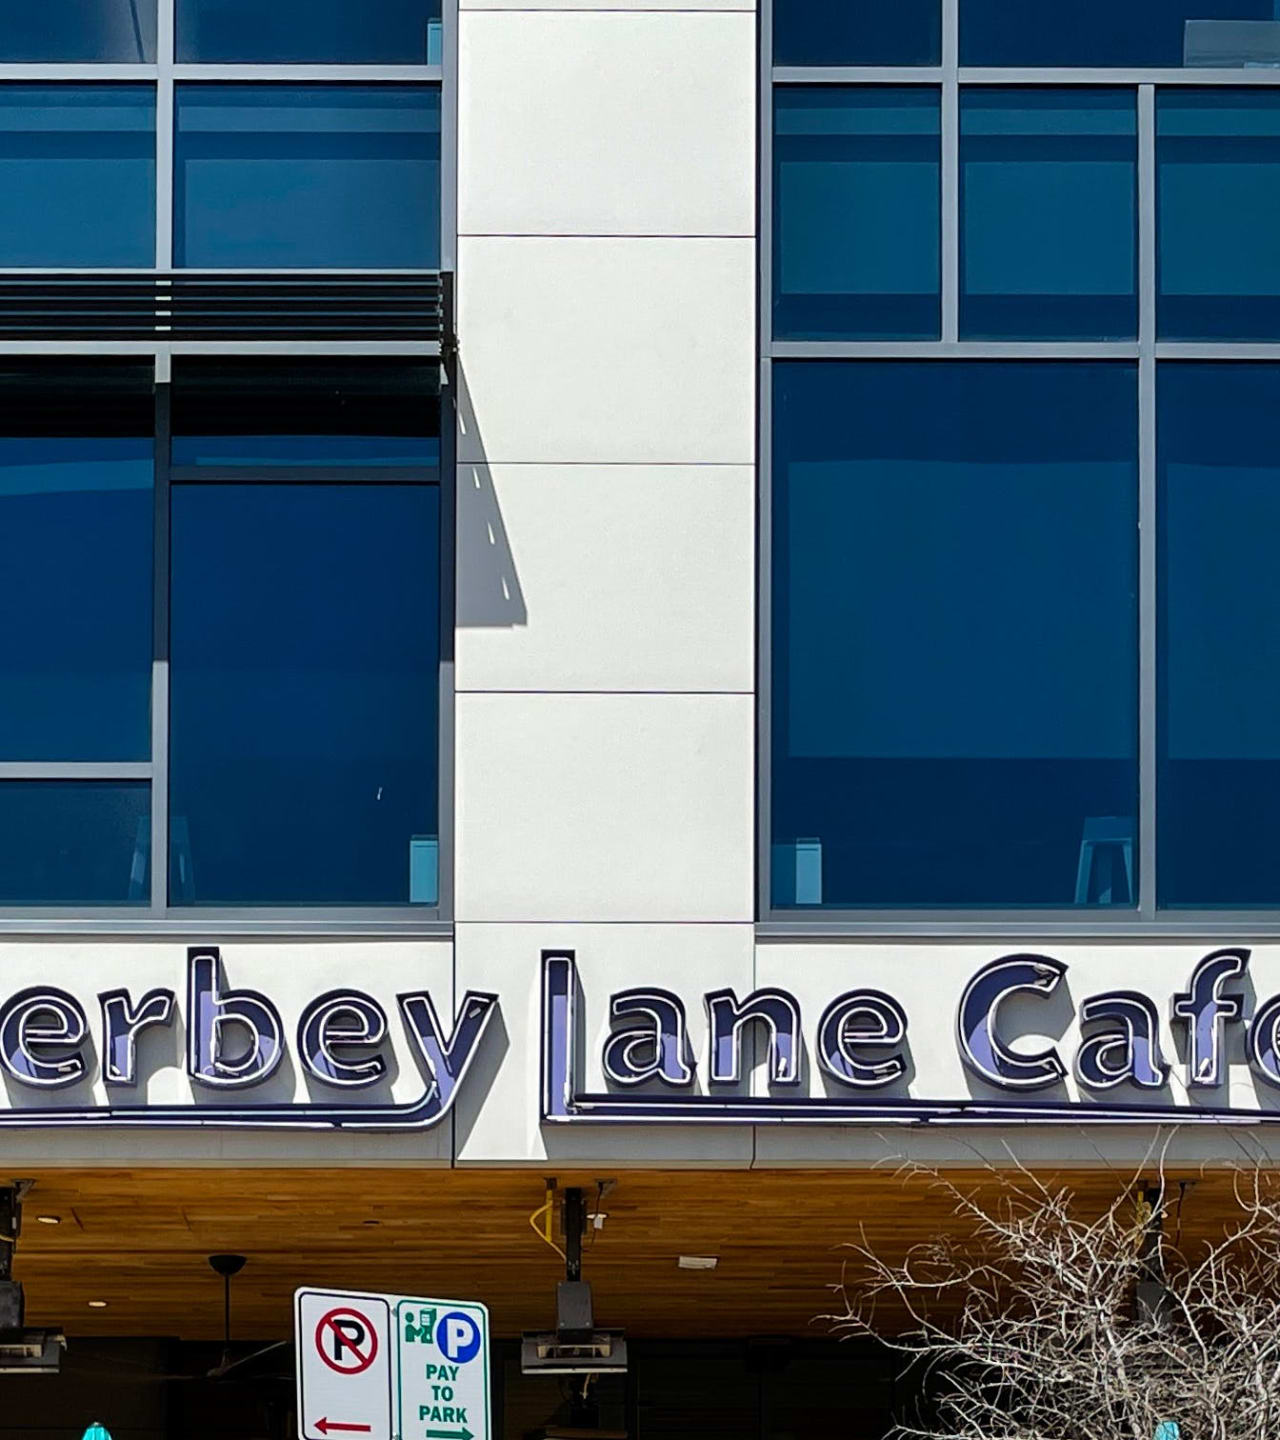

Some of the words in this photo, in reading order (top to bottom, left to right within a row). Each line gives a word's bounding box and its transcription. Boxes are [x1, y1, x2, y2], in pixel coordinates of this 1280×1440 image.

[540, 948, 909, 1125] Lane
[426, 1363, 460, 1381] PAY
[431, 1385, 454, 1402] TO
[419, 1404, 468, 1423] PARK
